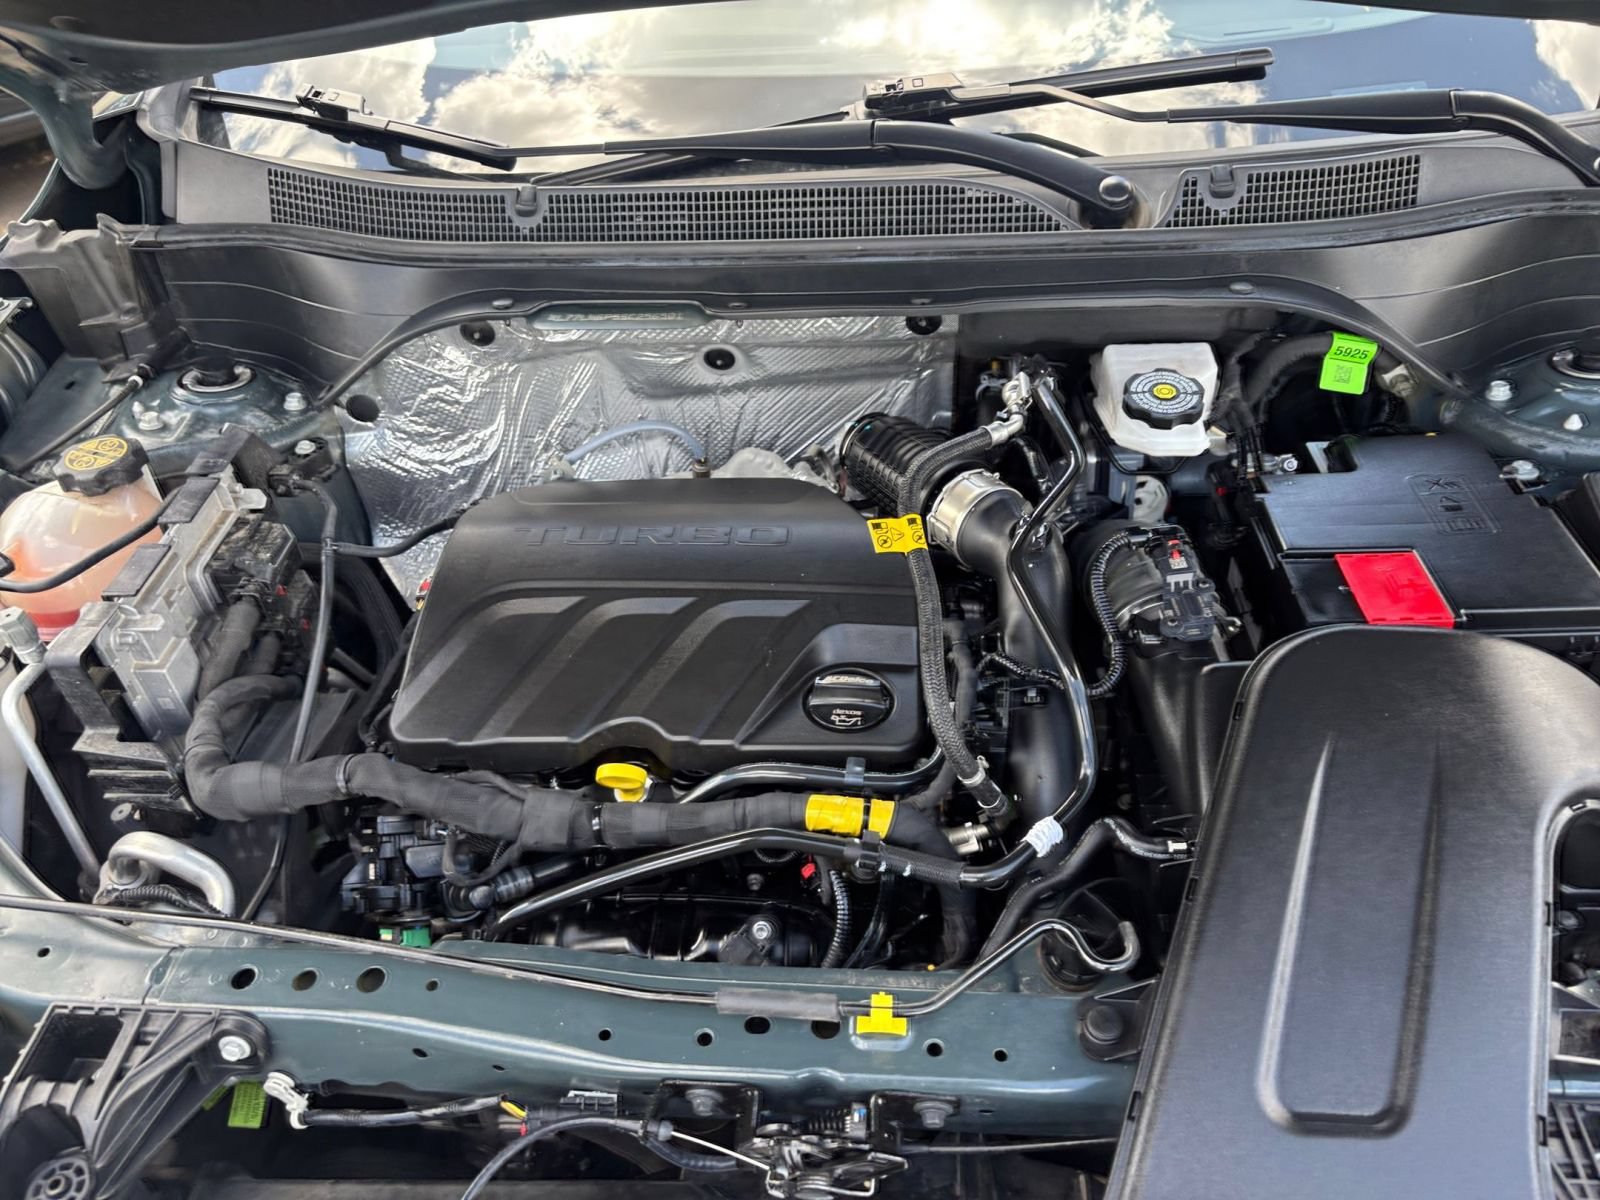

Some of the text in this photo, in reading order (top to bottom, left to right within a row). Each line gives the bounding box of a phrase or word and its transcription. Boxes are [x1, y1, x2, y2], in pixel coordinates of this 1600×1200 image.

[1334, 345, 1369, 360] 5925
[512, 525, 790, 547] TURBO
[832, 708, 863, 716] dexos
